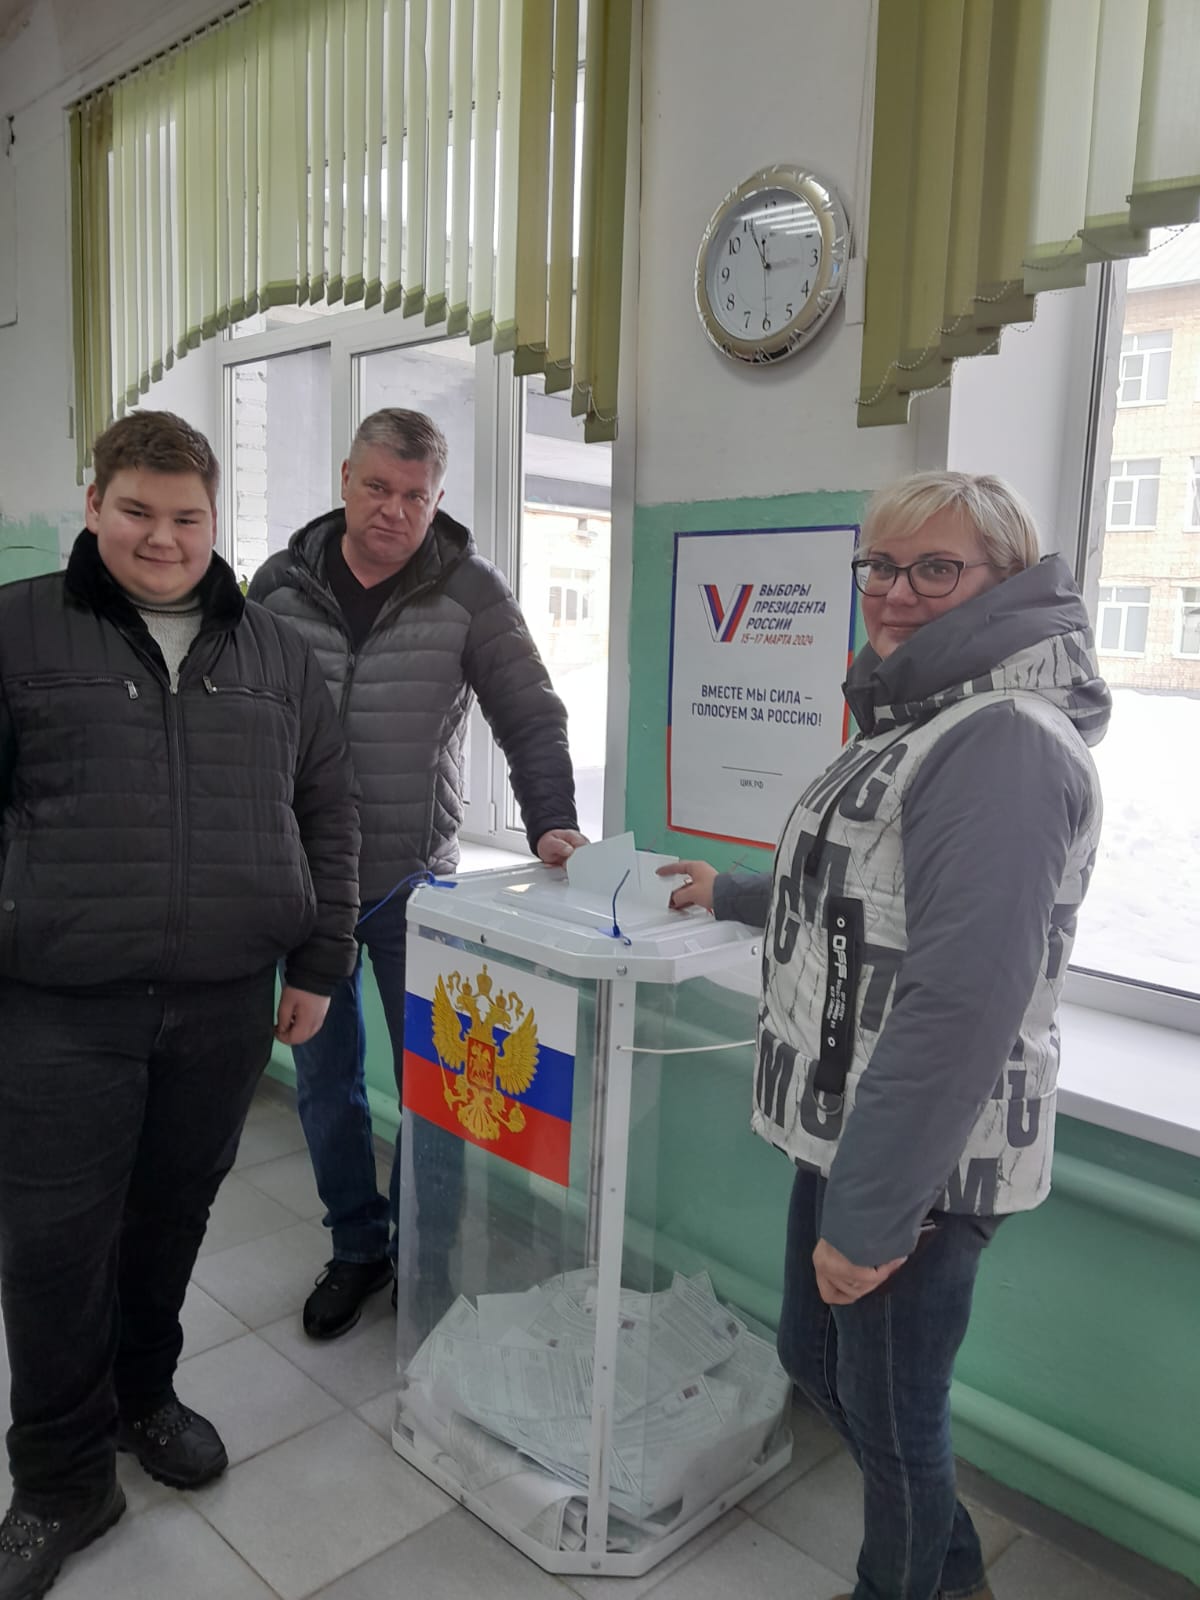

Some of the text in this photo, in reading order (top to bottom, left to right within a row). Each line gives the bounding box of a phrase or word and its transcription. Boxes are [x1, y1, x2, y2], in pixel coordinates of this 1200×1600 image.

[729, 237, 741, 255] 10
[808, 248, 818, 267] 3
[721, 267, 730, 285] 9
[800, 279, 809, 299] 4
[726, 292, 735, 311] 8
[743, 310, 751, 329] 7
[785, 303, 792, 321] 5
[762, 312, 771, 331] 6
[759, 584, 812, 597] ВЫБОРЫ
[752, 600, 827, 616] ПРЕЗИДЕНТА
[746, 617, 793, 631] РОССИИ
[763, 633, 792, 645] МАРТА
[792, 634, 814, 647] 2024
[701, 684, 743, 701] ВМЕСТЕ
[746, 687, 767, 703] МЫ
[769, 688, 801, 705] СИЛА
[691, 702, 822, 727] ГОЛОСУЕМ ЗА РОССИЮ!
